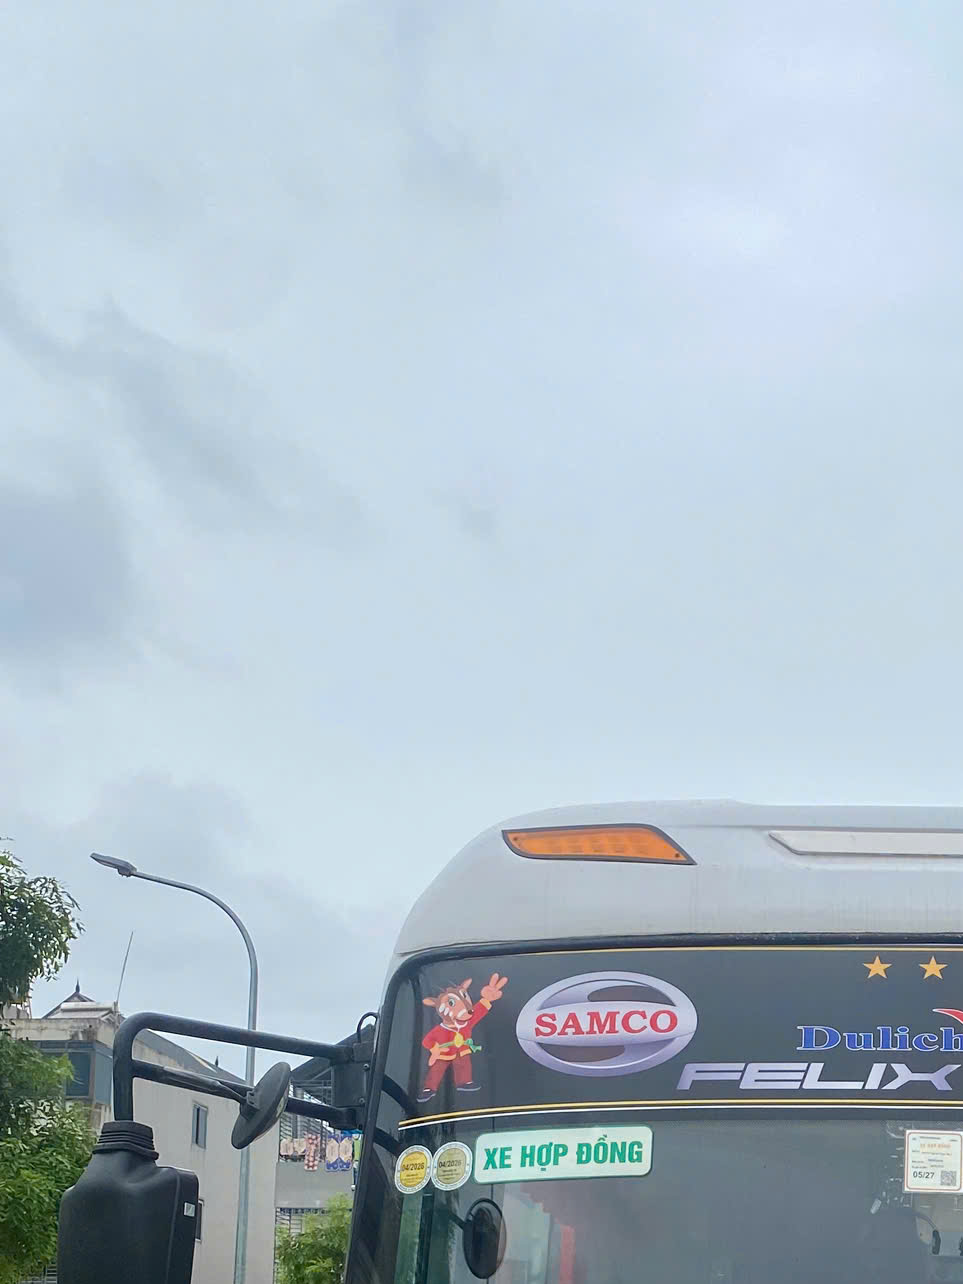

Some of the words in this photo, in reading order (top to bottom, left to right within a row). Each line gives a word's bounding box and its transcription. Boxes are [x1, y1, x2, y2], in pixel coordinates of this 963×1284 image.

[534, 1009, 678, 1037] SAMCO
[676, 1062, 961, 1091] FELIX
[483, 1146, 512, 1171] XE
[520, 1142, 568, 1171] HỢP
[576, 1134, 643, 1165] ĐỒNG
[912, 1170, 935, 1179] 05/27
